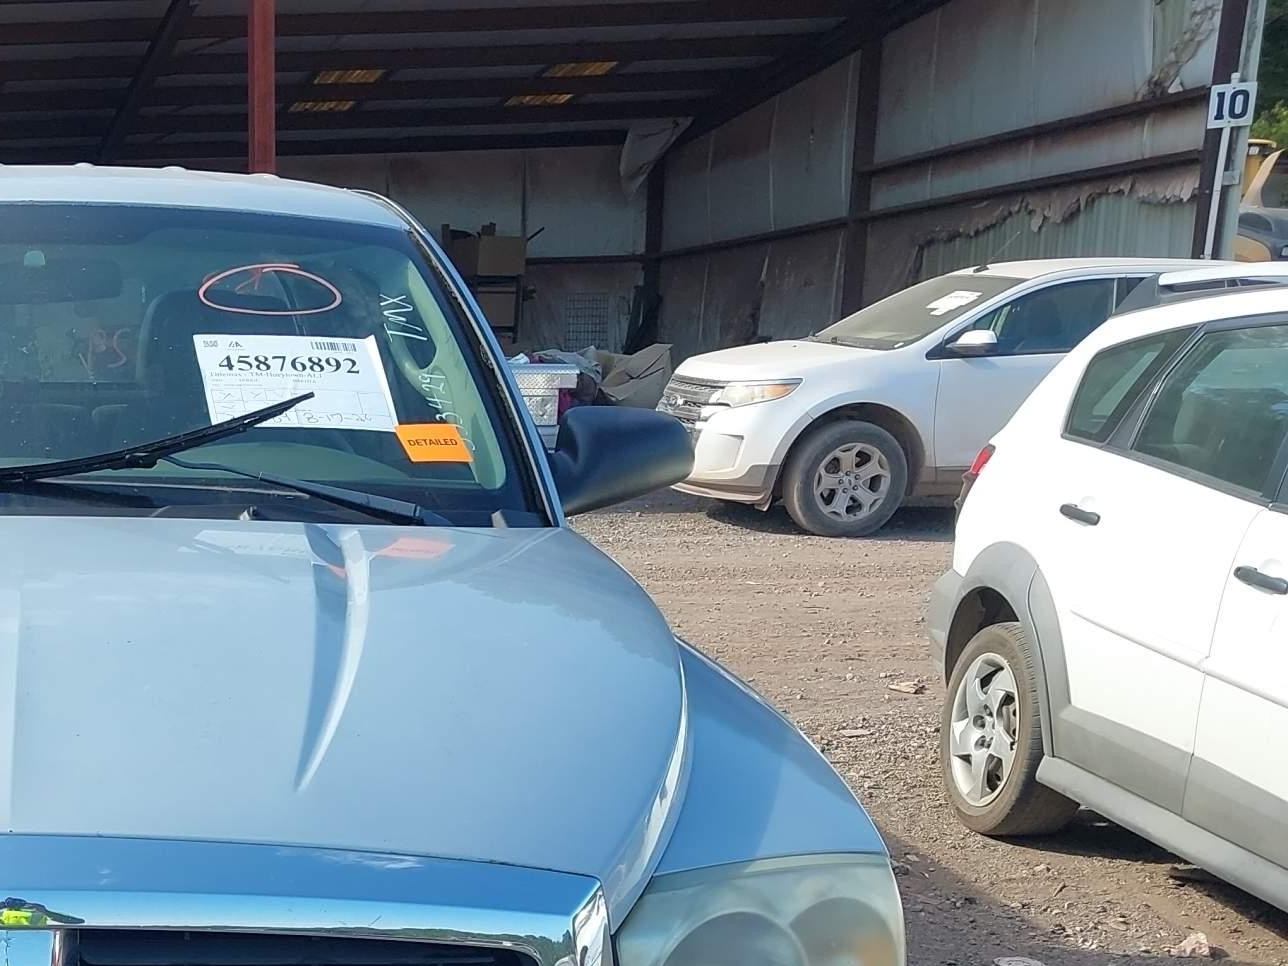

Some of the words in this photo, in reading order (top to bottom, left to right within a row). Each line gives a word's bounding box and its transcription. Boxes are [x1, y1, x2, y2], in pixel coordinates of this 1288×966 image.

[1214, 89, 1250, 120] 10
[379, 294, 428, 343] TMX
[218, 355, 360, 374] 45876892
[407, 438, 458, 447] DETAILED
